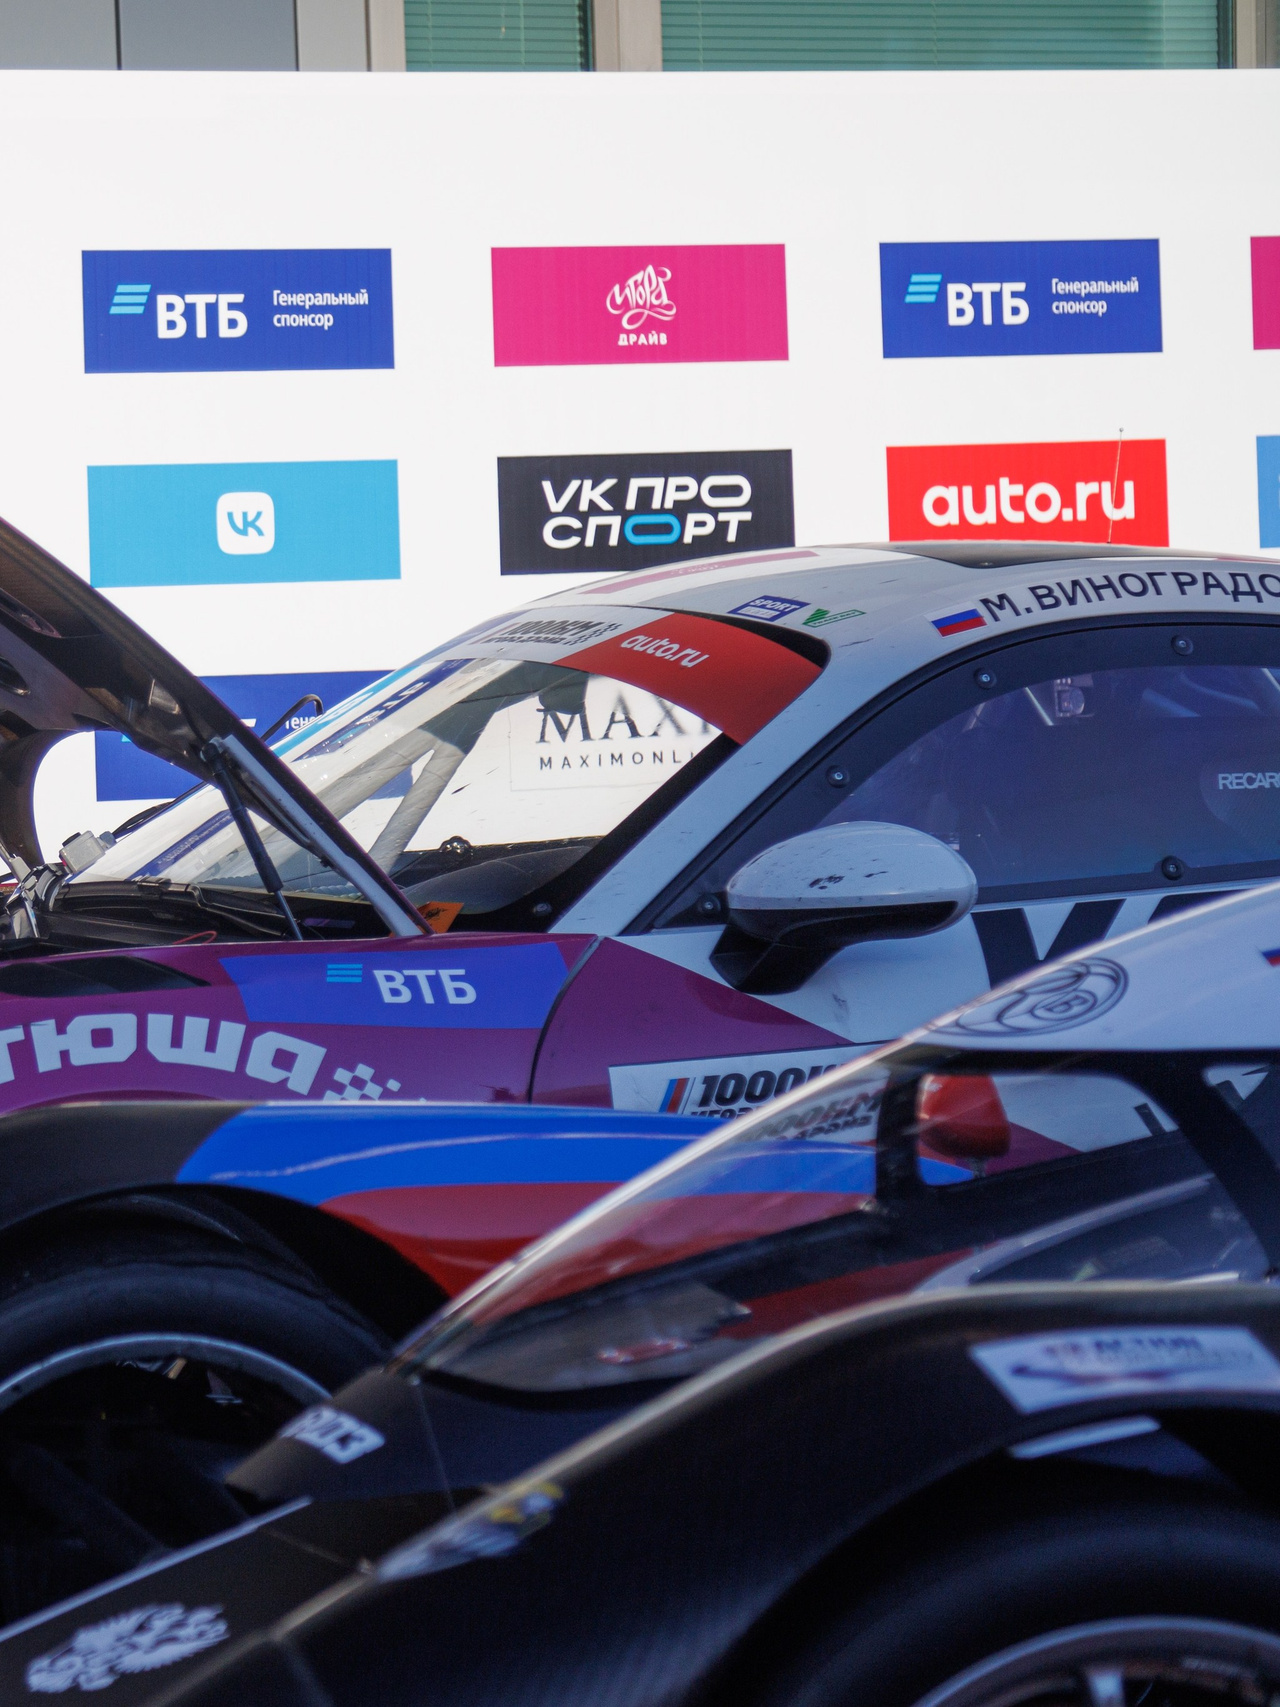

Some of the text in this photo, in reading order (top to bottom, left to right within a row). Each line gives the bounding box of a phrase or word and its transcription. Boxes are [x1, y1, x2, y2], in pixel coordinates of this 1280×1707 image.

[273, 289, 369, 309] Генеральный
[1052, 277, 1139, 297] Генеральный
[157, 294, 248, 338] ВТБ
[947, 282, 1030, 326] ВТБ
[1052, 299, 1108, 316] спонсор
[273, 312, 334, 330] спонсор
[618, 330, 668, 346] ДРАЙВ
[625, 475, 752, 511] ПРО
[922, 477, 1136, 527] auto.ru
[542, 511, 752, 549] СПОРТ
[749, 599, 801, 612] SPORT
[620, 635, 710, 668] auto.ru
[373, 968, 477, 1005] ВТБ
